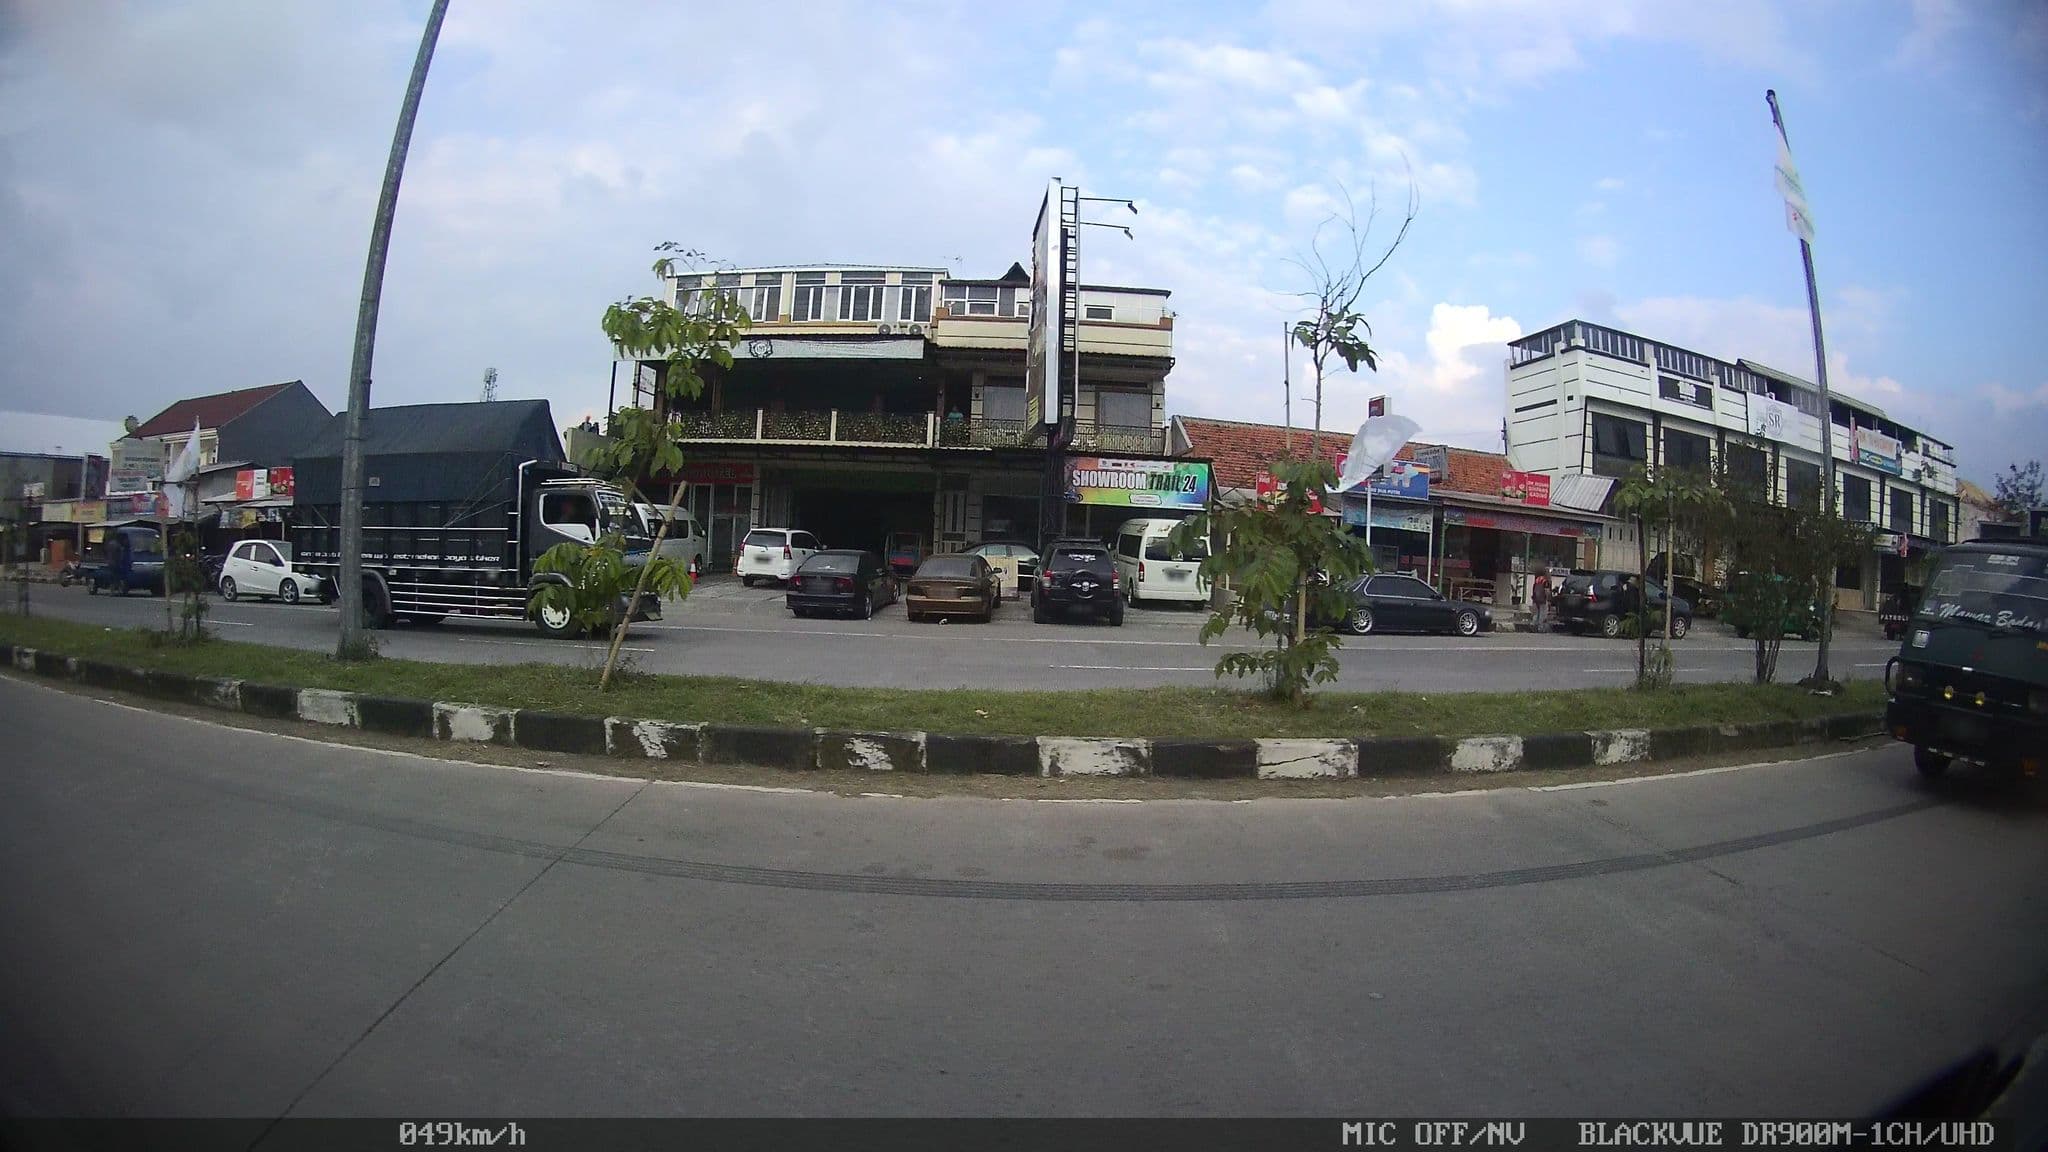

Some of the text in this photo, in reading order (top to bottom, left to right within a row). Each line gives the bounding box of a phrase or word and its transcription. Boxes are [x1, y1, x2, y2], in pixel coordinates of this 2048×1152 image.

[1072, 469, 1197, 493] SHOWROOM TRAIL 24
